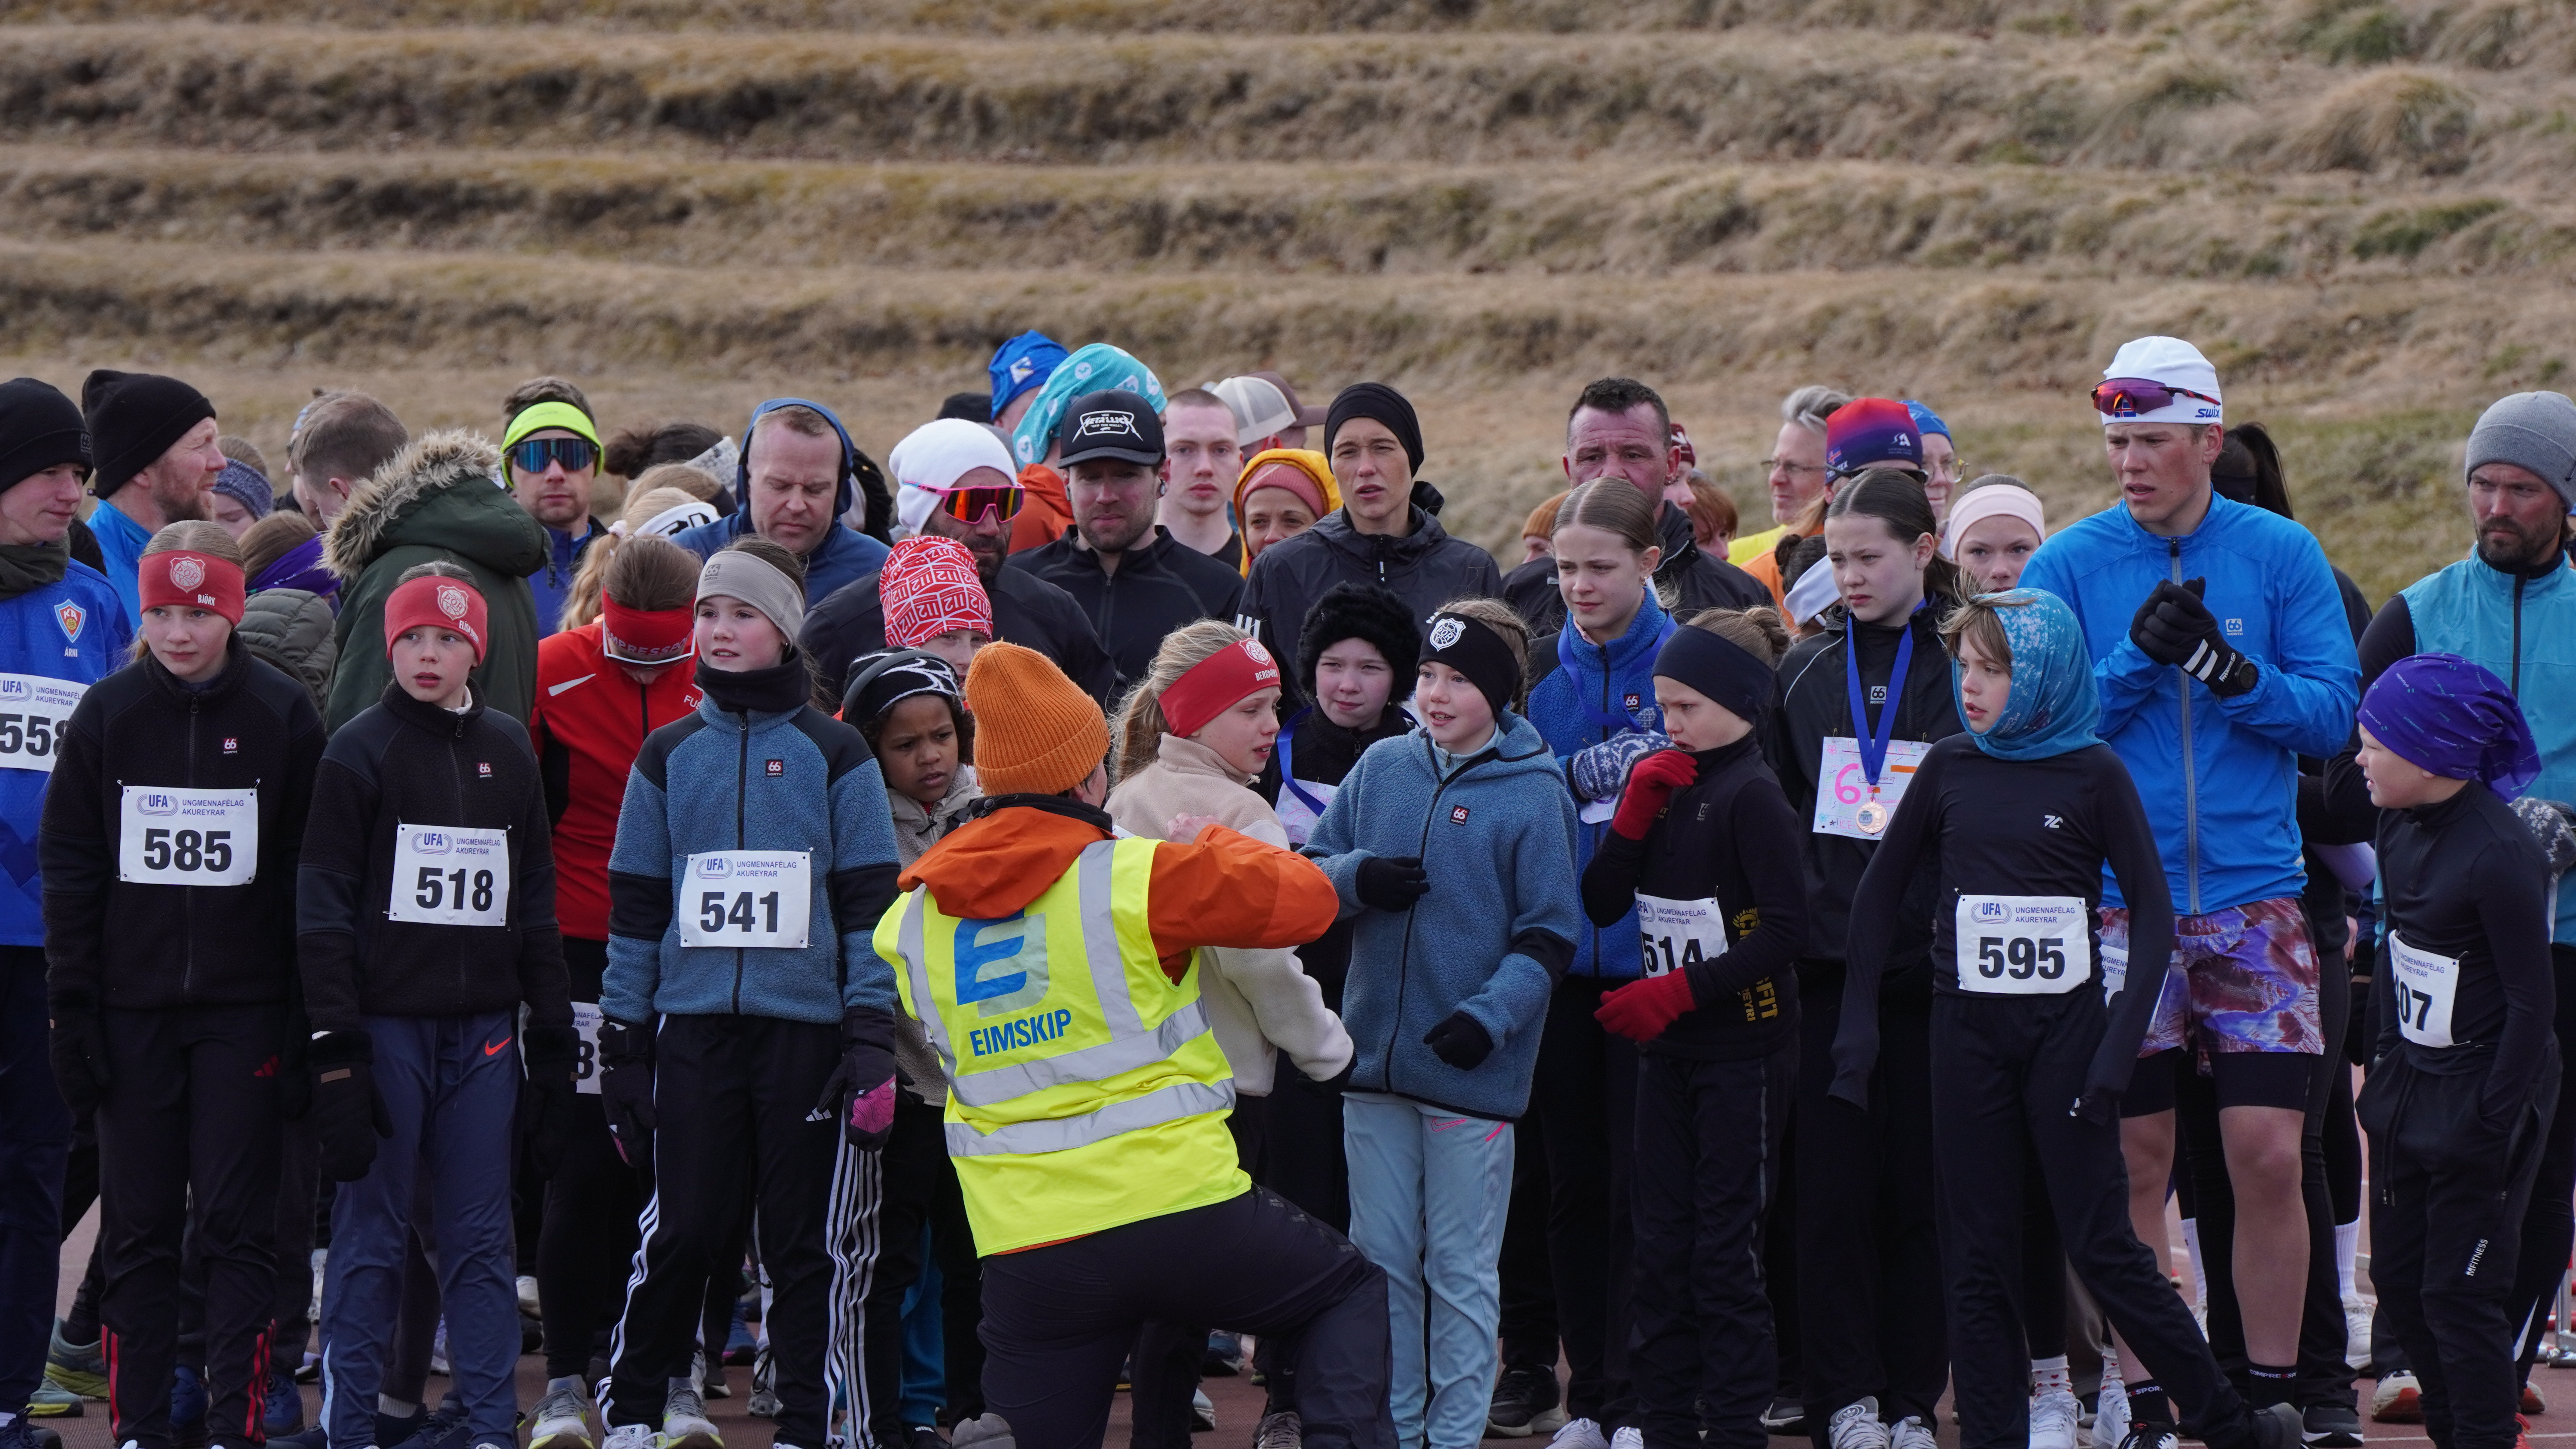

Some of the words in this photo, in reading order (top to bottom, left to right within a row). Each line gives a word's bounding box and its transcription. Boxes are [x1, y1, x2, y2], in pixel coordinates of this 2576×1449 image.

[911, 574, 931, 591] 112
[936, 571, 959, 581] 112
[944, 594, 964, 612] 112
[64, 608, 78, 621] KA
[917, 603, 939, 618] 112
[64, 646, 78, 658] ÁRNI
[2, 680, 22, 693] UFA
[36, 685, 82, 700] UNGMENNAFÉL
[35, 695, 73, 707] AKUREYRAR
[1835, 763, 1862, 805] 6
[148, 794, 168, 808] UFA
[182, 798, 244, 807] UNGMENNAFÉLAG
[423, 832, 443, 846] UFA
[456, 837, 501, 846] UNGMENNAFÉLAG
[144, 828, 232, 872] 585
[455, 847, 490, 855] AKUREYRAR
[706, 858, 723, 871] UFA
[736, 860, 797, 868] UNGMENNAFÉLAG
[415, 867, 494, 912] 518
[700, 891, 778, 933] 541
[1656, 907, 1707, 917] UNGMENNAFÉLAG
[1982, 903, 2002, 915] UFA
[2015, 906, 2075, 914] UNGMENNAFÉLAG
[1657, 916, 1691, 925] AKUREYRAR
[1642, 931, 1703, 975] 514
[1978, 936, 2066, 979] 595
[2395, 973, 2433, 1032] 07
[969, 1009, 1072, 1057] EIMSKIP
